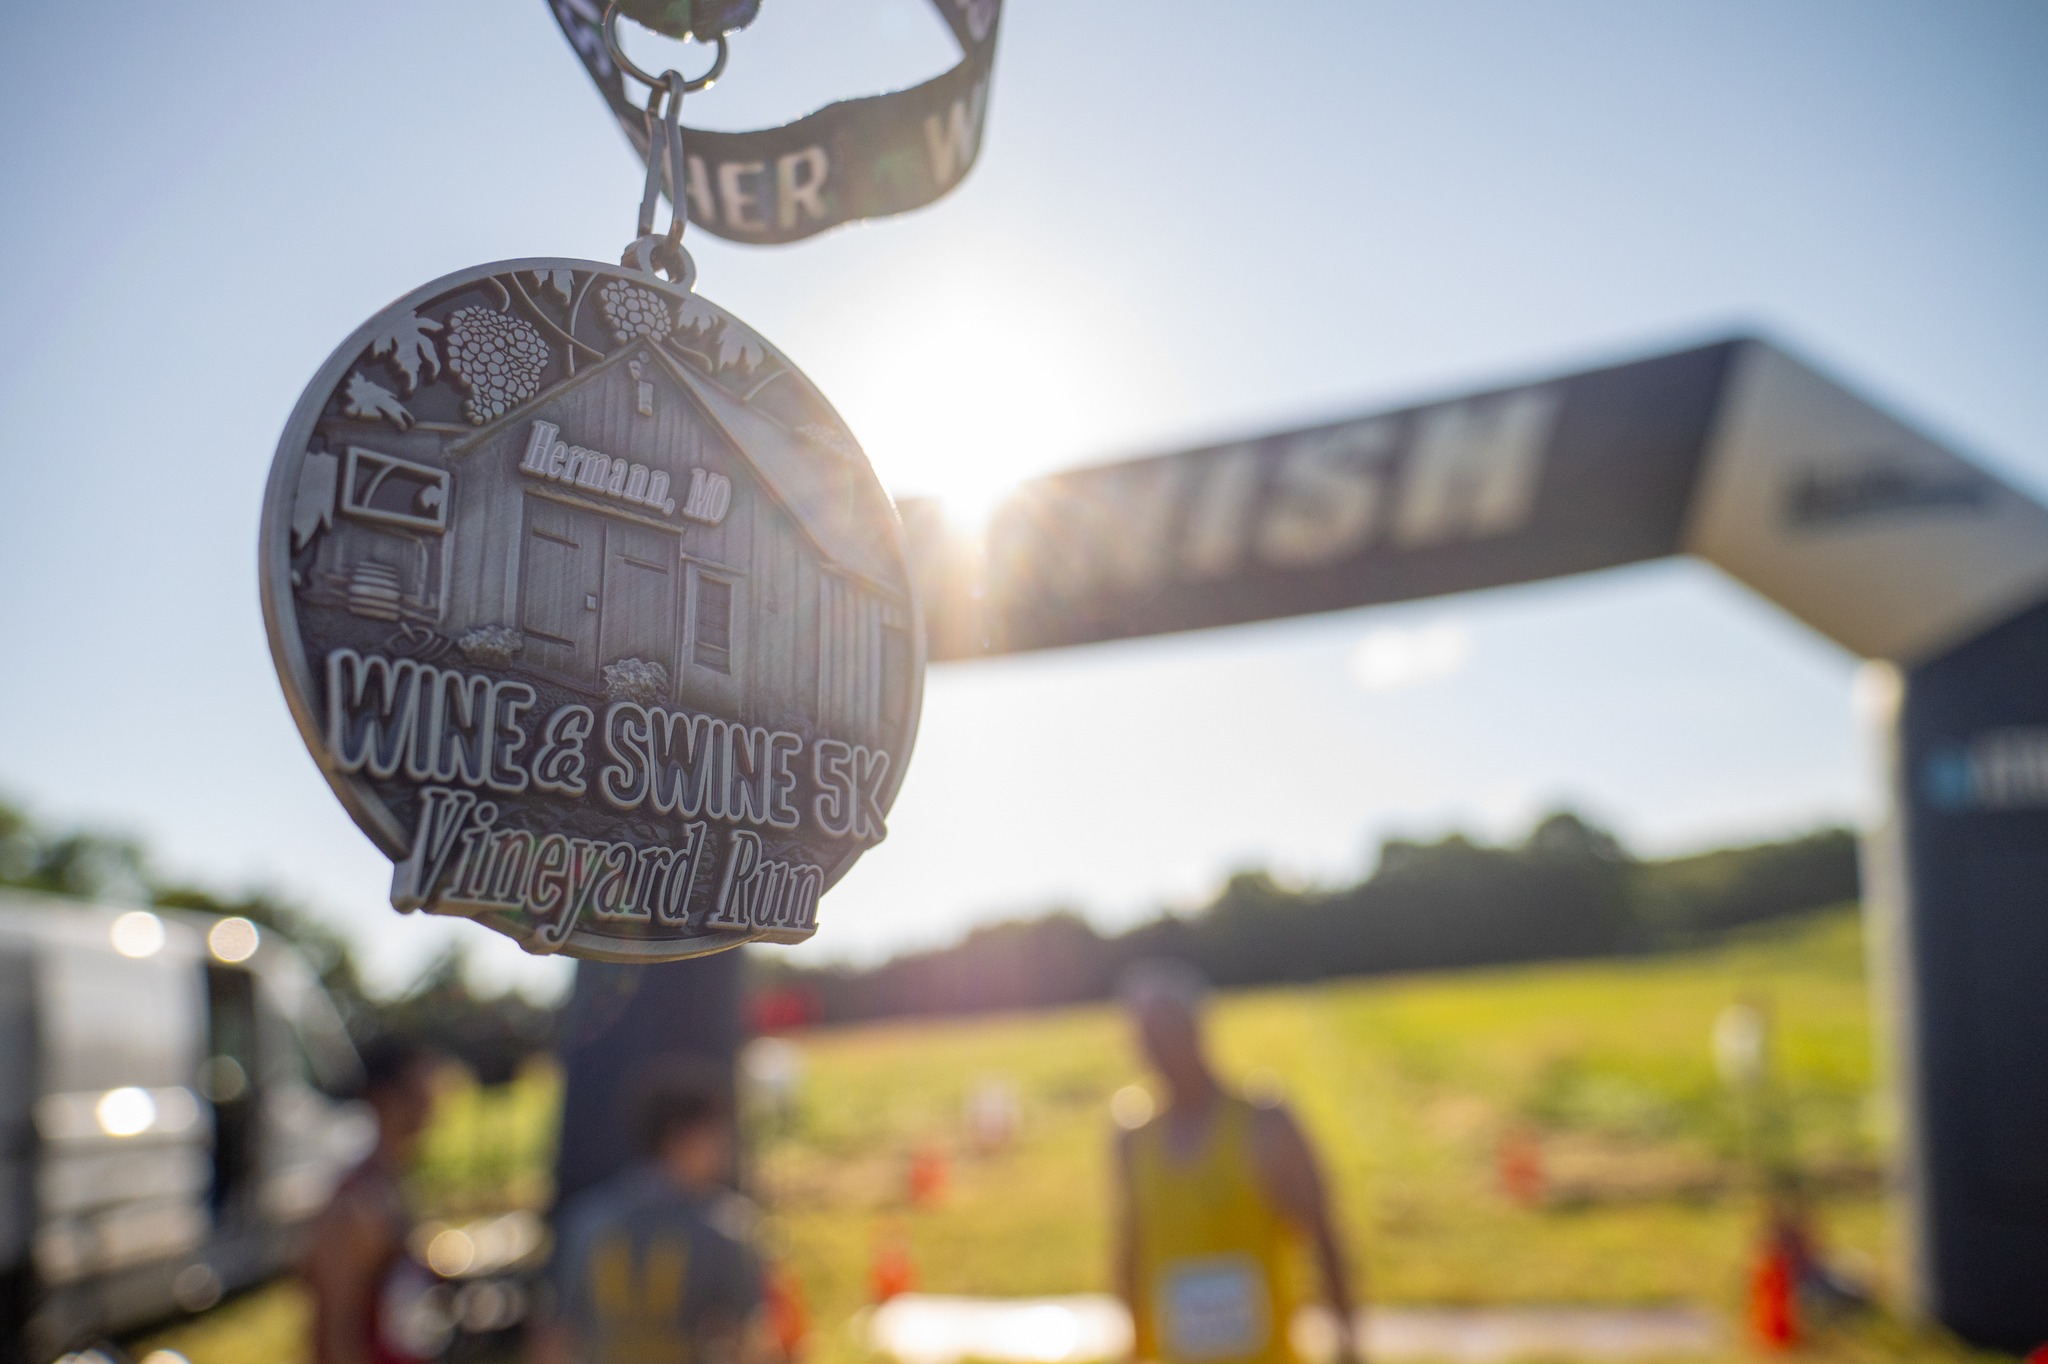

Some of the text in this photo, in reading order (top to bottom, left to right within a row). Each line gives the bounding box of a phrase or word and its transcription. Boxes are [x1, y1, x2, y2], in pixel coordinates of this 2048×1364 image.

[520, 420, 732, 525] Hermann, MO
[326, 648, 890, 841] WINE & SWINE 5K
[411, 787, 826, 948] Vineyard Run
